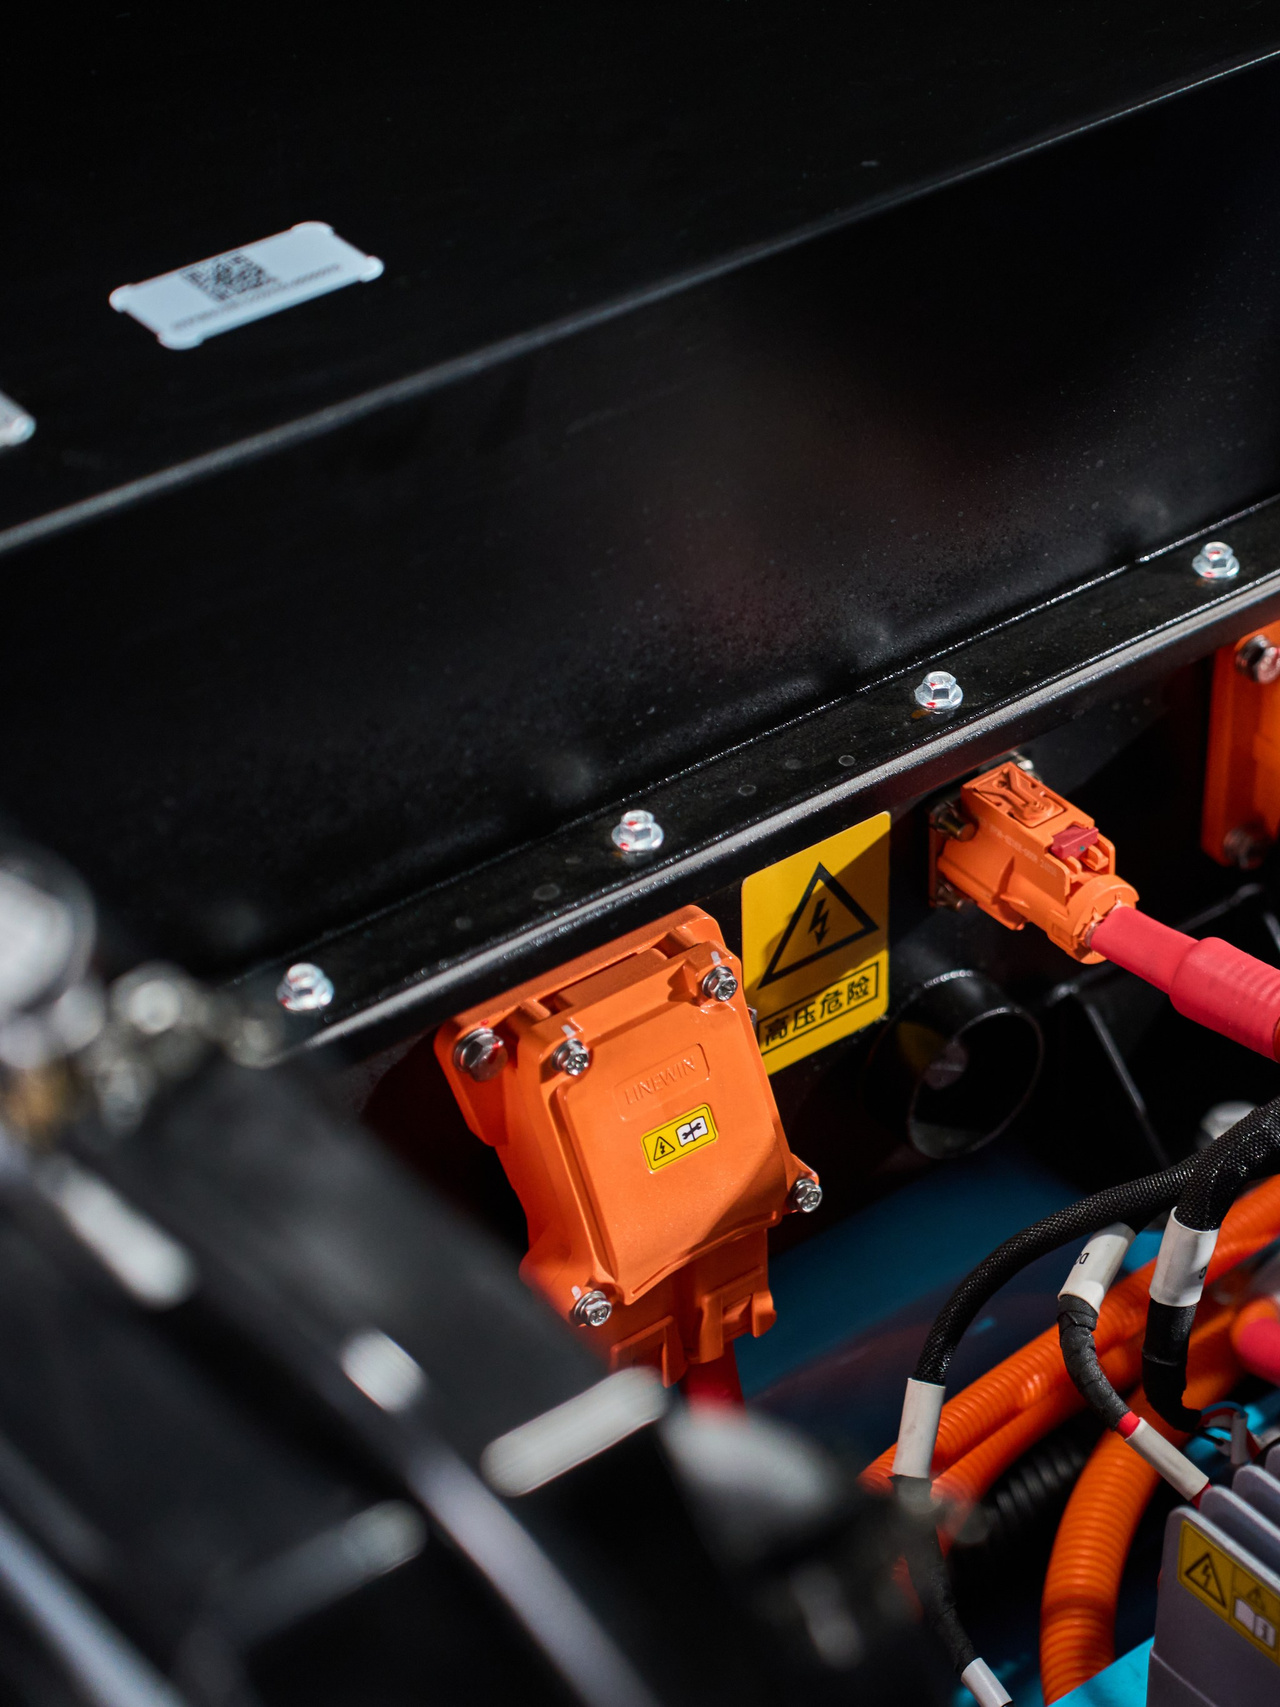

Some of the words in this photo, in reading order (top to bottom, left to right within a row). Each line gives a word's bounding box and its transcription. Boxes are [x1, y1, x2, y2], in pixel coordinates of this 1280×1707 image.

[765, 975, 870, 1046] 高压危险
[624, 1056, 696, 1105] LINEWIN
